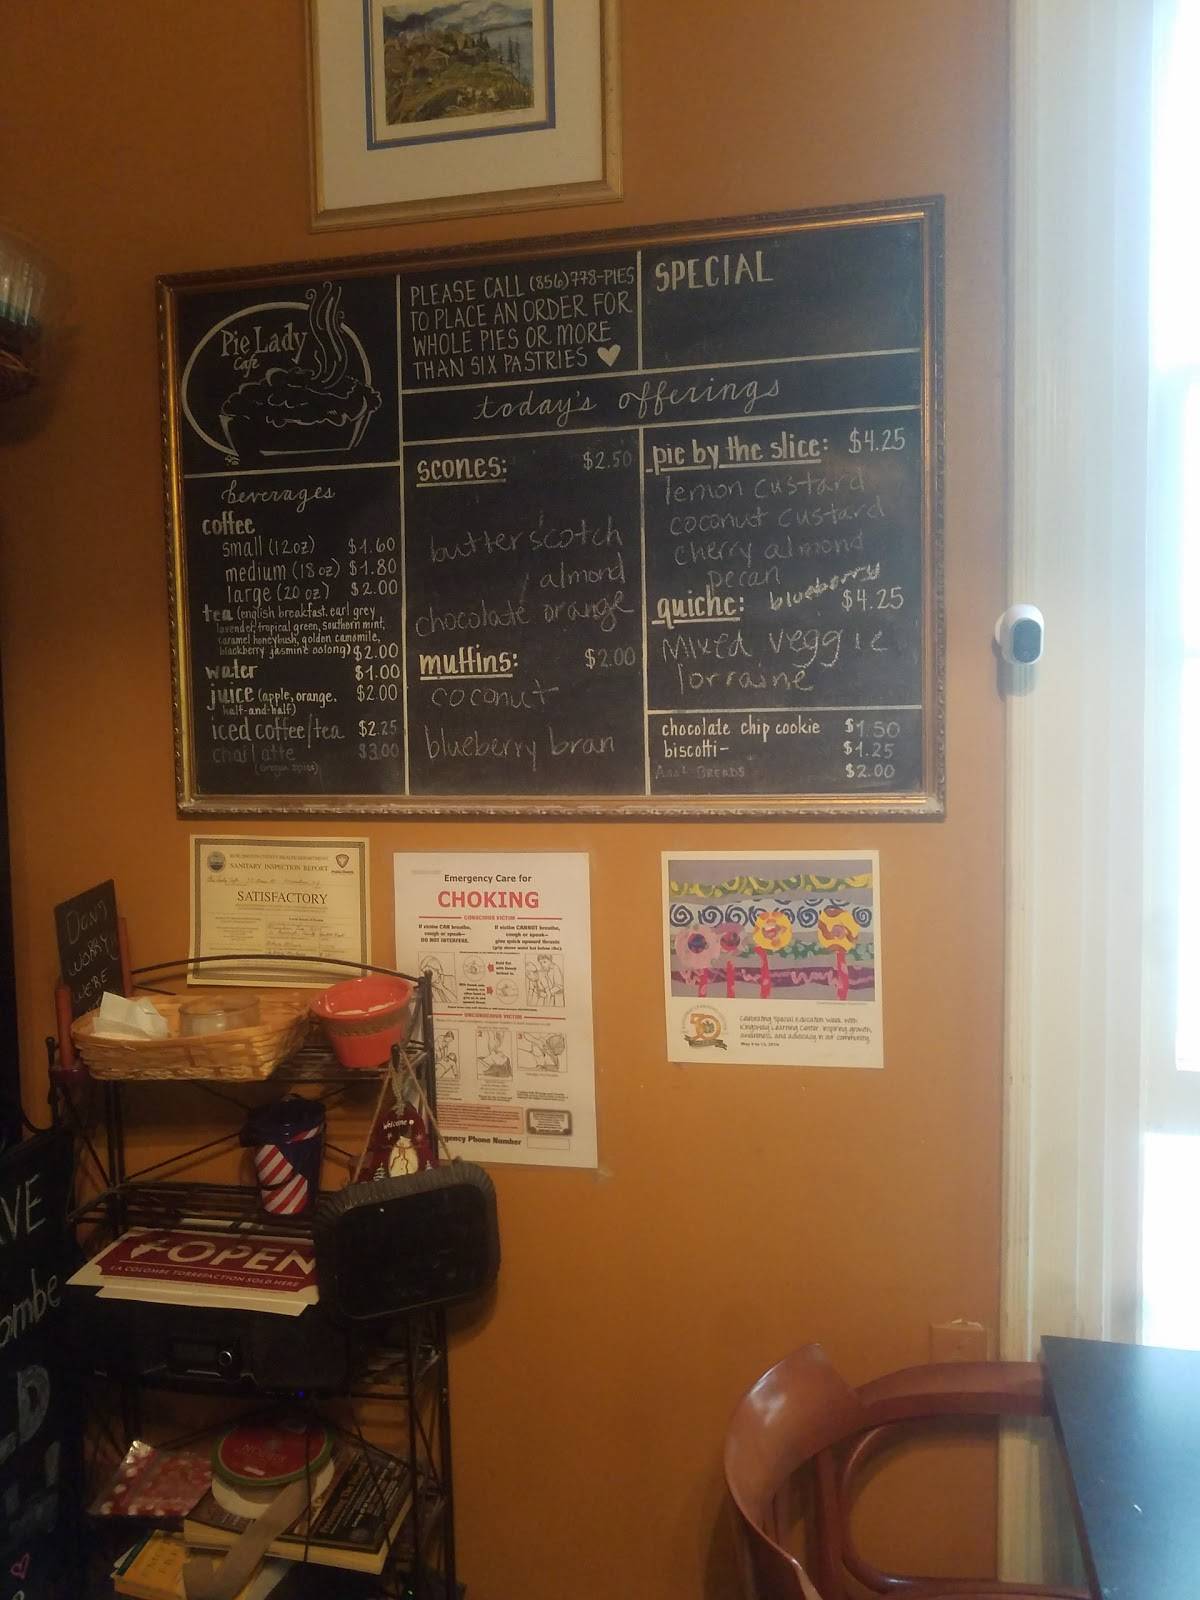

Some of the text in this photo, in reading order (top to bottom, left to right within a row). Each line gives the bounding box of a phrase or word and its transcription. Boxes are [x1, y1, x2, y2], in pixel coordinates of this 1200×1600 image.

[655, 250, 774, 292] SPECIAL
[410, 279, 476, 307] PLEASE
[484, 274, 525, 299] CALL
[410, 290, 633, 332] TO PLACE AN ORDER FOR
[220, 321, 308, 364] Pie Lady
[412, 320, 611, 358] WHOLE PIES OR MORE
[412, 346, 588, 381] THAN SIX PASTRIES
[473, 377, 780, 427] today's offerings
[652, 430, 829, 476] pie by the slice:
[848, 427, 905, 454] $4.25
[416, 450, 633, 482] scones: $2.50
[221, 479, 336, 513] beverages
[665, 468, 865, 506] lemon custard
[202, 510, 256, 536] coffee
[778, 496, 885, 528] custard
[222, 535, 262, 558] small
[348, 537, 395, 555] $1.60
[673, 531, 865, 568] cherry almond
[225, 561, 286, 583] medium
[348, 558, 397, 576] $1.80
[540, 552, 626, 589] almond
[707, 566, 782, 590] pecan
[227, 585, 272, 609] large
[350, 579, 398, 597] $2.00
[657, 584, 905, 630] quiche: $4.25
[202, 604, 233, 622] tea
[237, 606, 276, 626] (english
[330, 601, 350, 617] earl
[353, 605, 376, 620] grey
[258, 620, 291, 635] tropical
[322, 618, 360, 631] southern
[416, 590, 635, 637] chocolate orange
[269, 645, 309, 660] jasmine
[302, 632, 333, 645] golden
[353, 642, 399, 662] $2.00
[205, 659, 400, 681] water $1.00
[419, 644, 636, 675] muffins: $2.00
[206, 682, 255, 711] juice
[258, 688, 294, 702] (apple,
[357, 684, 398, 702] $2.00
[431, 679, 559, 709] coconut
[211, 714, 252, 741] iced
[358, 720, 399, 738] $2.25
[662, 714, 900, 743] chocolate chip cookie $1.50
[359, 743, 399, 760] $3.00
[424, 725, 615, 772] blueberry bran
[843, 740, 894, 759] $1.25
[844, 763, 896, 780] $2.00
[229, 862, 328, 873] SANITARY INSPECTION REPORT
[444, 874, 532, 884] Emergency Care for
[238, 890, 328, 905] SATISFACTORY
[438, 891, 540, 909] CHOKING
[468, 1136, 491, 1144] Phone
[167, 1240, 316, 1275] OPEN
